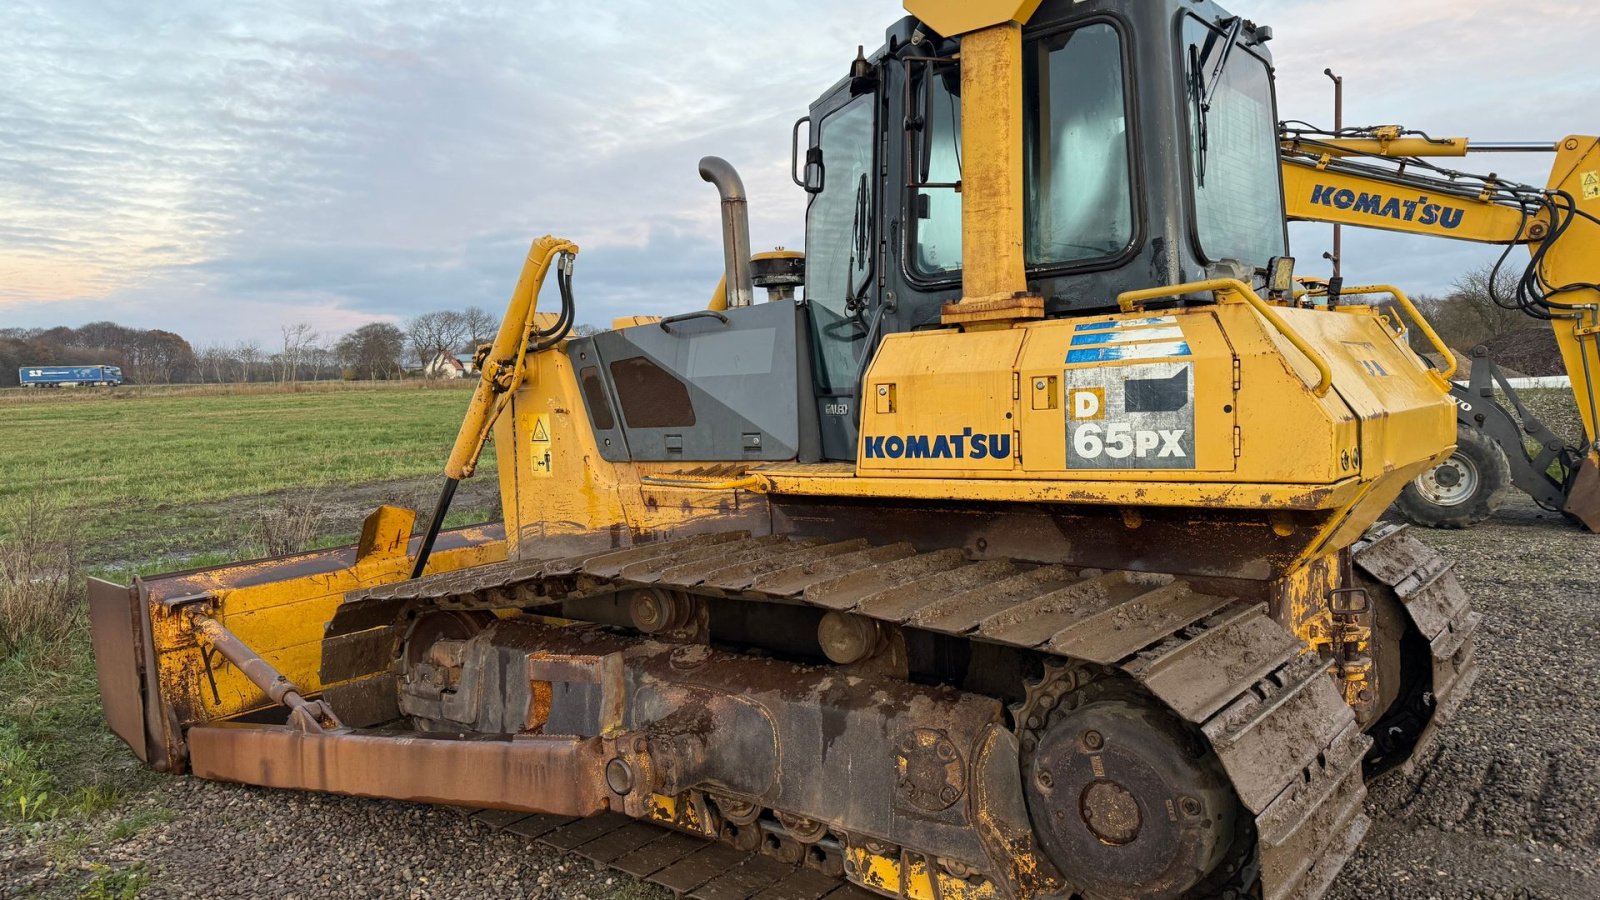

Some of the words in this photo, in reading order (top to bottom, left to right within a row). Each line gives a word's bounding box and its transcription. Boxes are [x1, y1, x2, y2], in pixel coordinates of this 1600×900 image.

[1310, 184, 1465, 229] KOMATSU
[1075, 391, 1099, 418] D
[865, 427, 1011, 459] KOMATSU
[1073, 422, 1187, 459] 65PX
